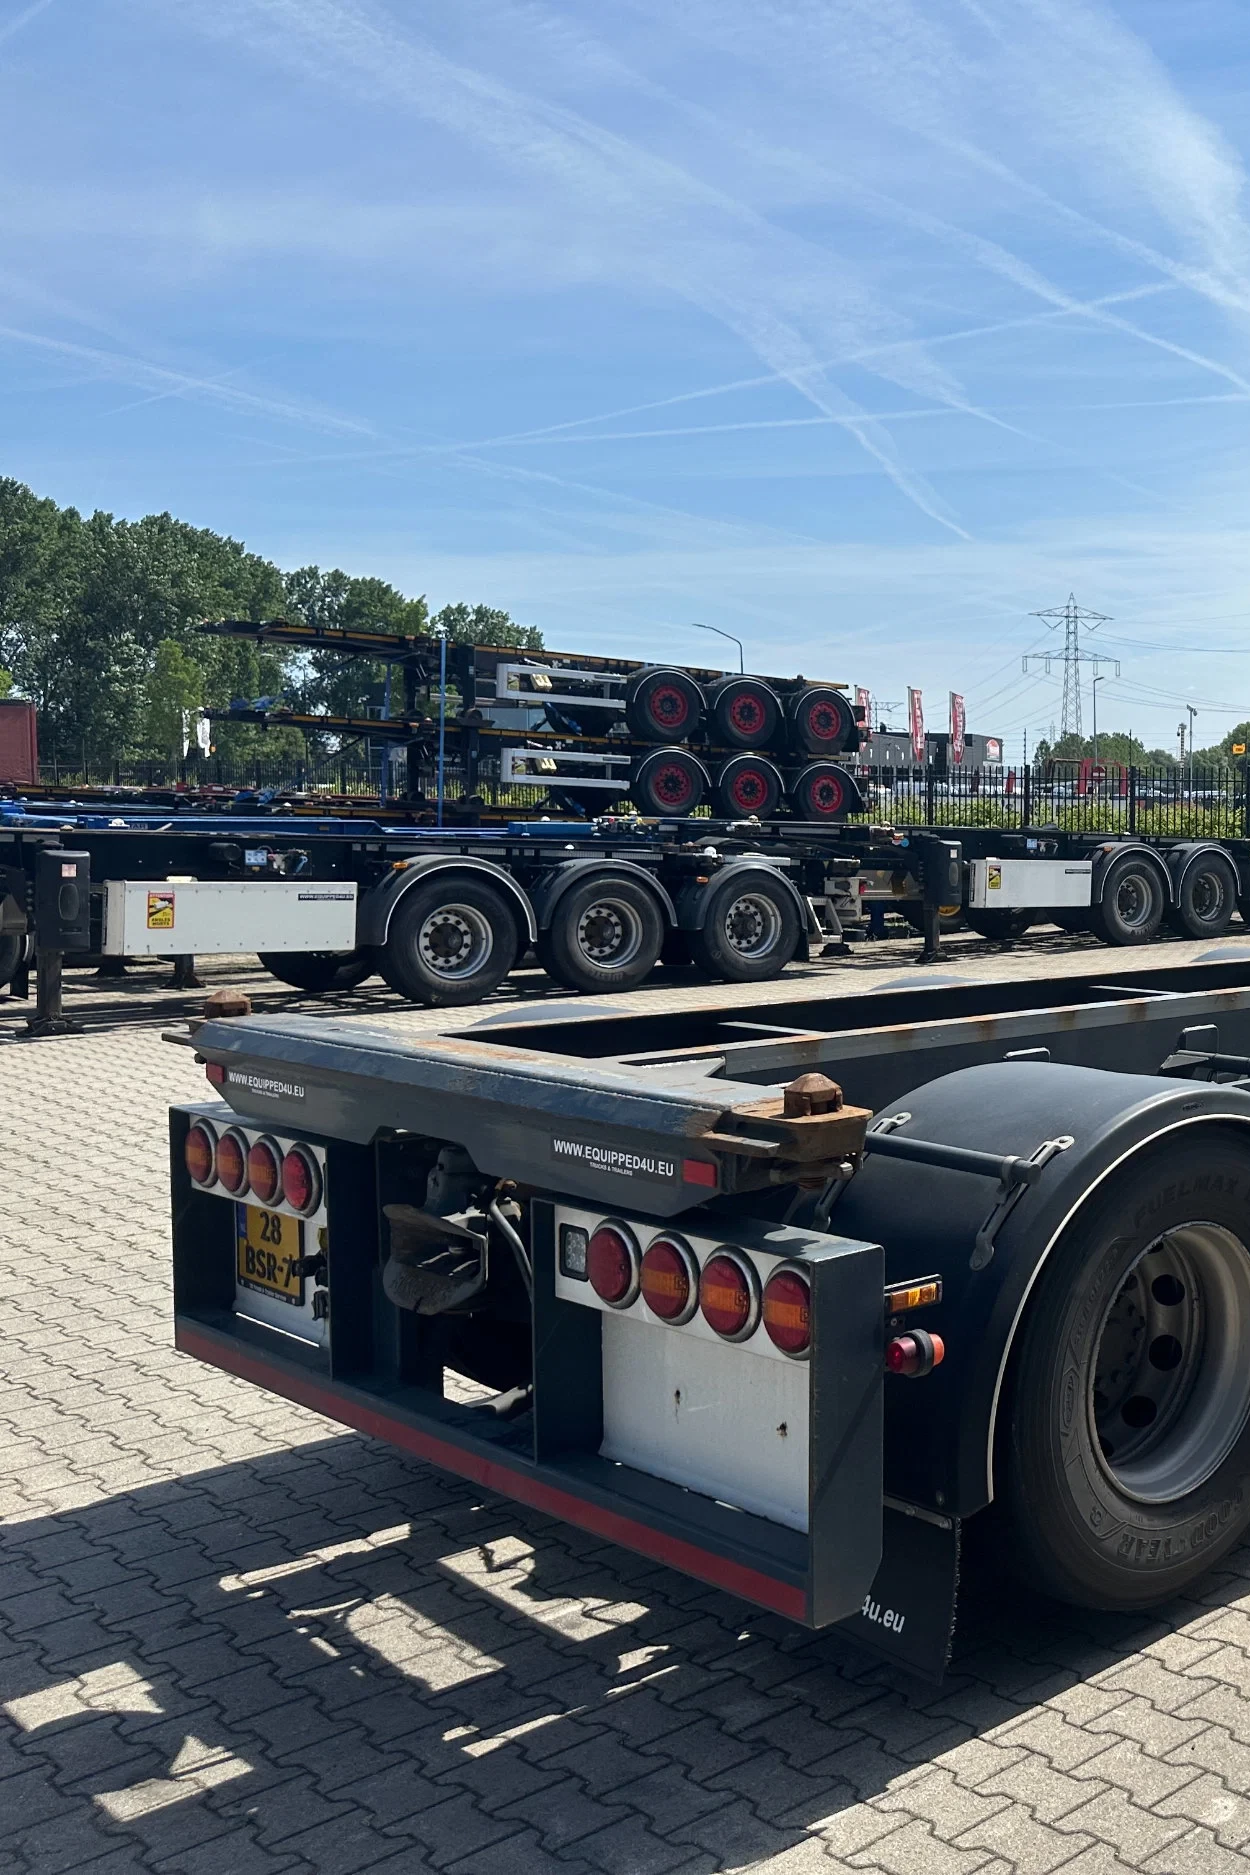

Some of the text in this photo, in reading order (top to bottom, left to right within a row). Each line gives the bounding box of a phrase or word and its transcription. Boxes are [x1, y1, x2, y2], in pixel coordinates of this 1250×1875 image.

[228, 1071, 305, 1098] WWW.EQUIPPED4U.EU
[553, 1139, 674, 1177] WWW.EQUIPPED4U.EU
[589, 1161, 607, 1171] TRUCKS
[611, 1166, 633, 1176] TRAILERS
[260, 1211, 282, 1245] 28
[245, 1245, 295, 1288] BSR-7
